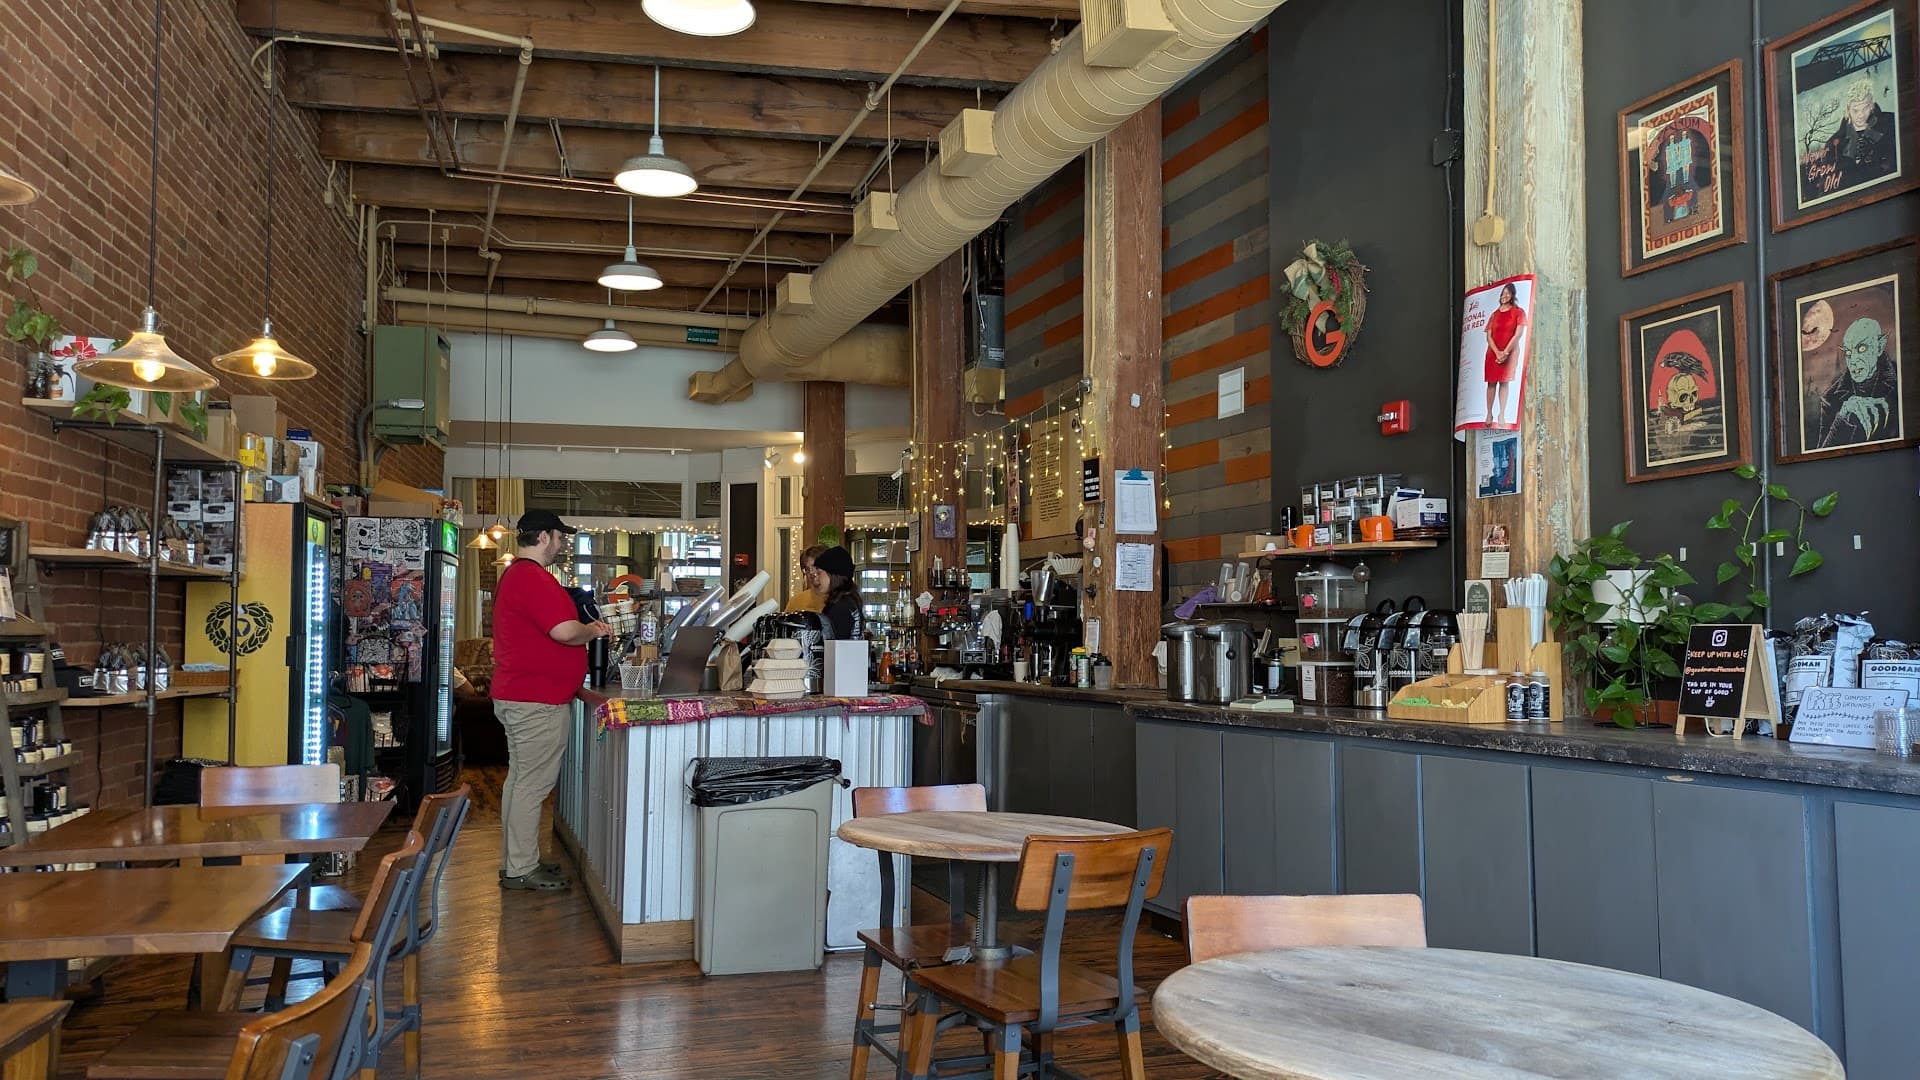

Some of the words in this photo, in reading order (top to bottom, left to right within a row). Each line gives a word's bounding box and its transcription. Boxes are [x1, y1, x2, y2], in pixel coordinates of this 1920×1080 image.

[1808, 162, 1836, 182] Grow
[1824, 171, 1842, 192] Old
[1305, 300, 1347, 367] G
[1471, 319, 1485, 329] RED
[1807, 689, 1841, 710] FREE
